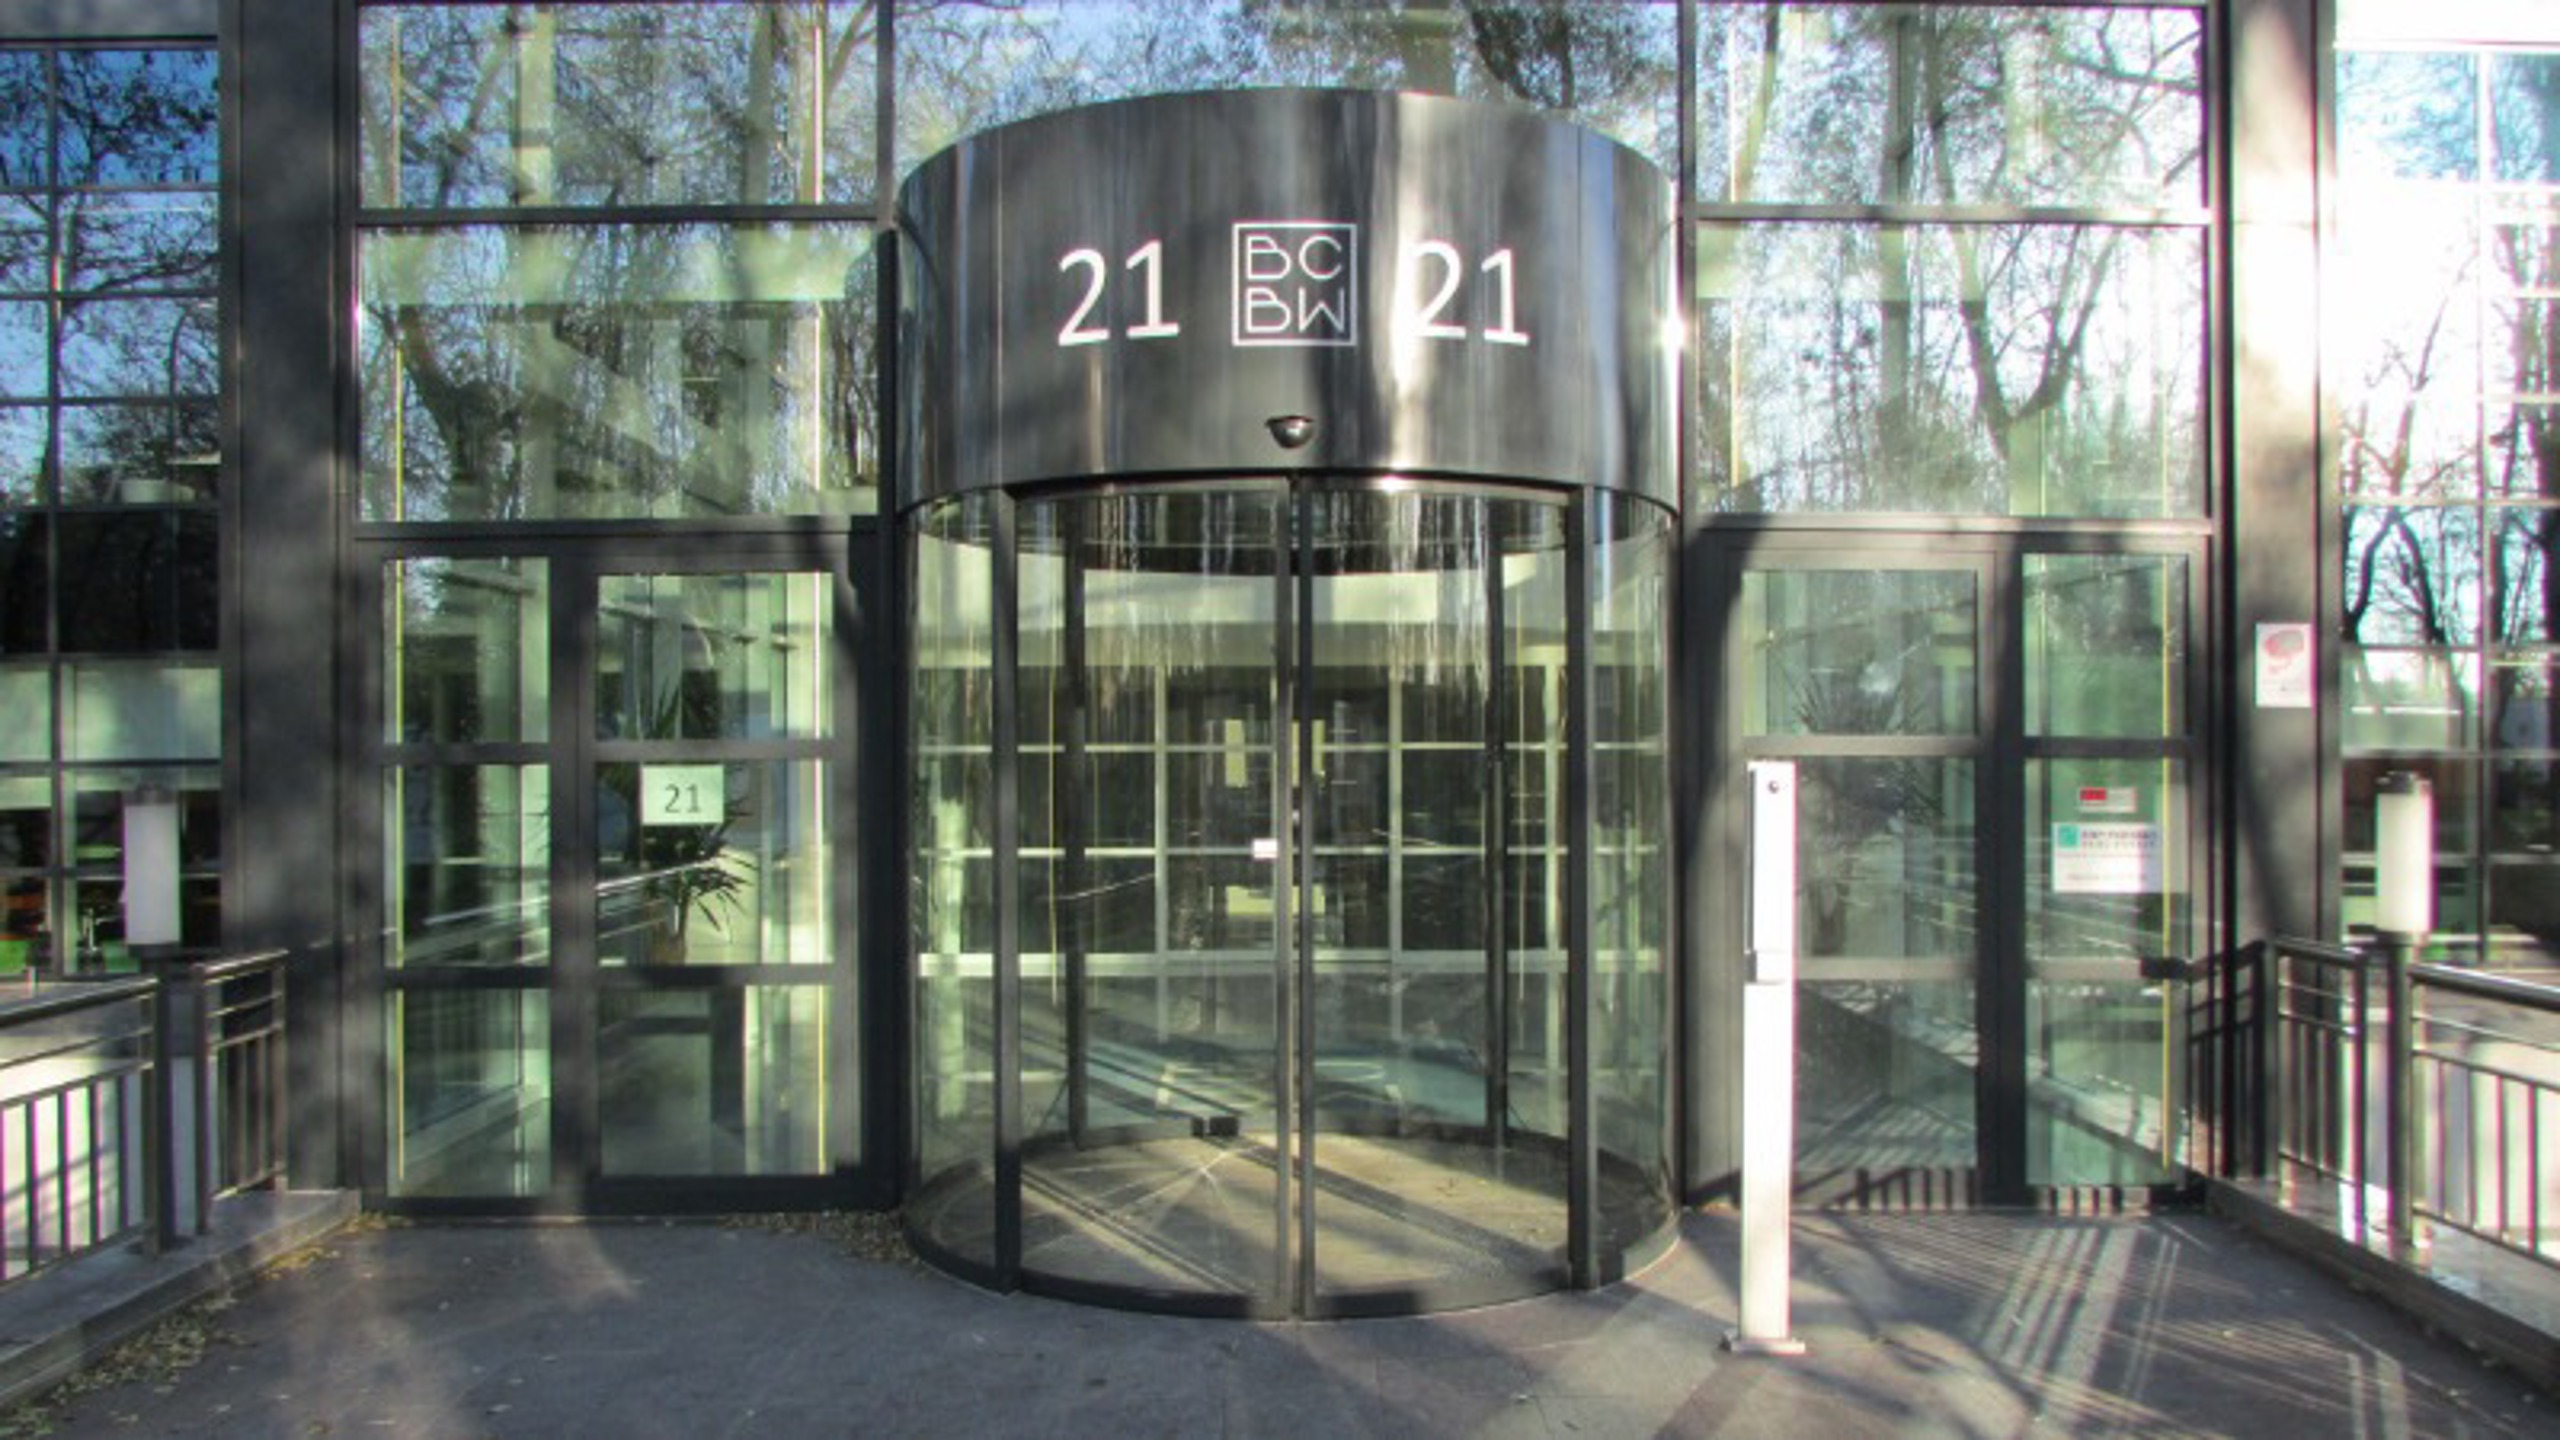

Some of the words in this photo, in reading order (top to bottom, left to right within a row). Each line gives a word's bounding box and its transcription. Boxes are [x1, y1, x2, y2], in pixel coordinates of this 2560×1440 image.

[1246, 236, 1342, 281] BC
[1058, 240, 1180, 346] 21
[1246, 287, 1346, 334] BW
[1409, 240, 1530, 346] 21
[664, 784, 700, 814] 21
